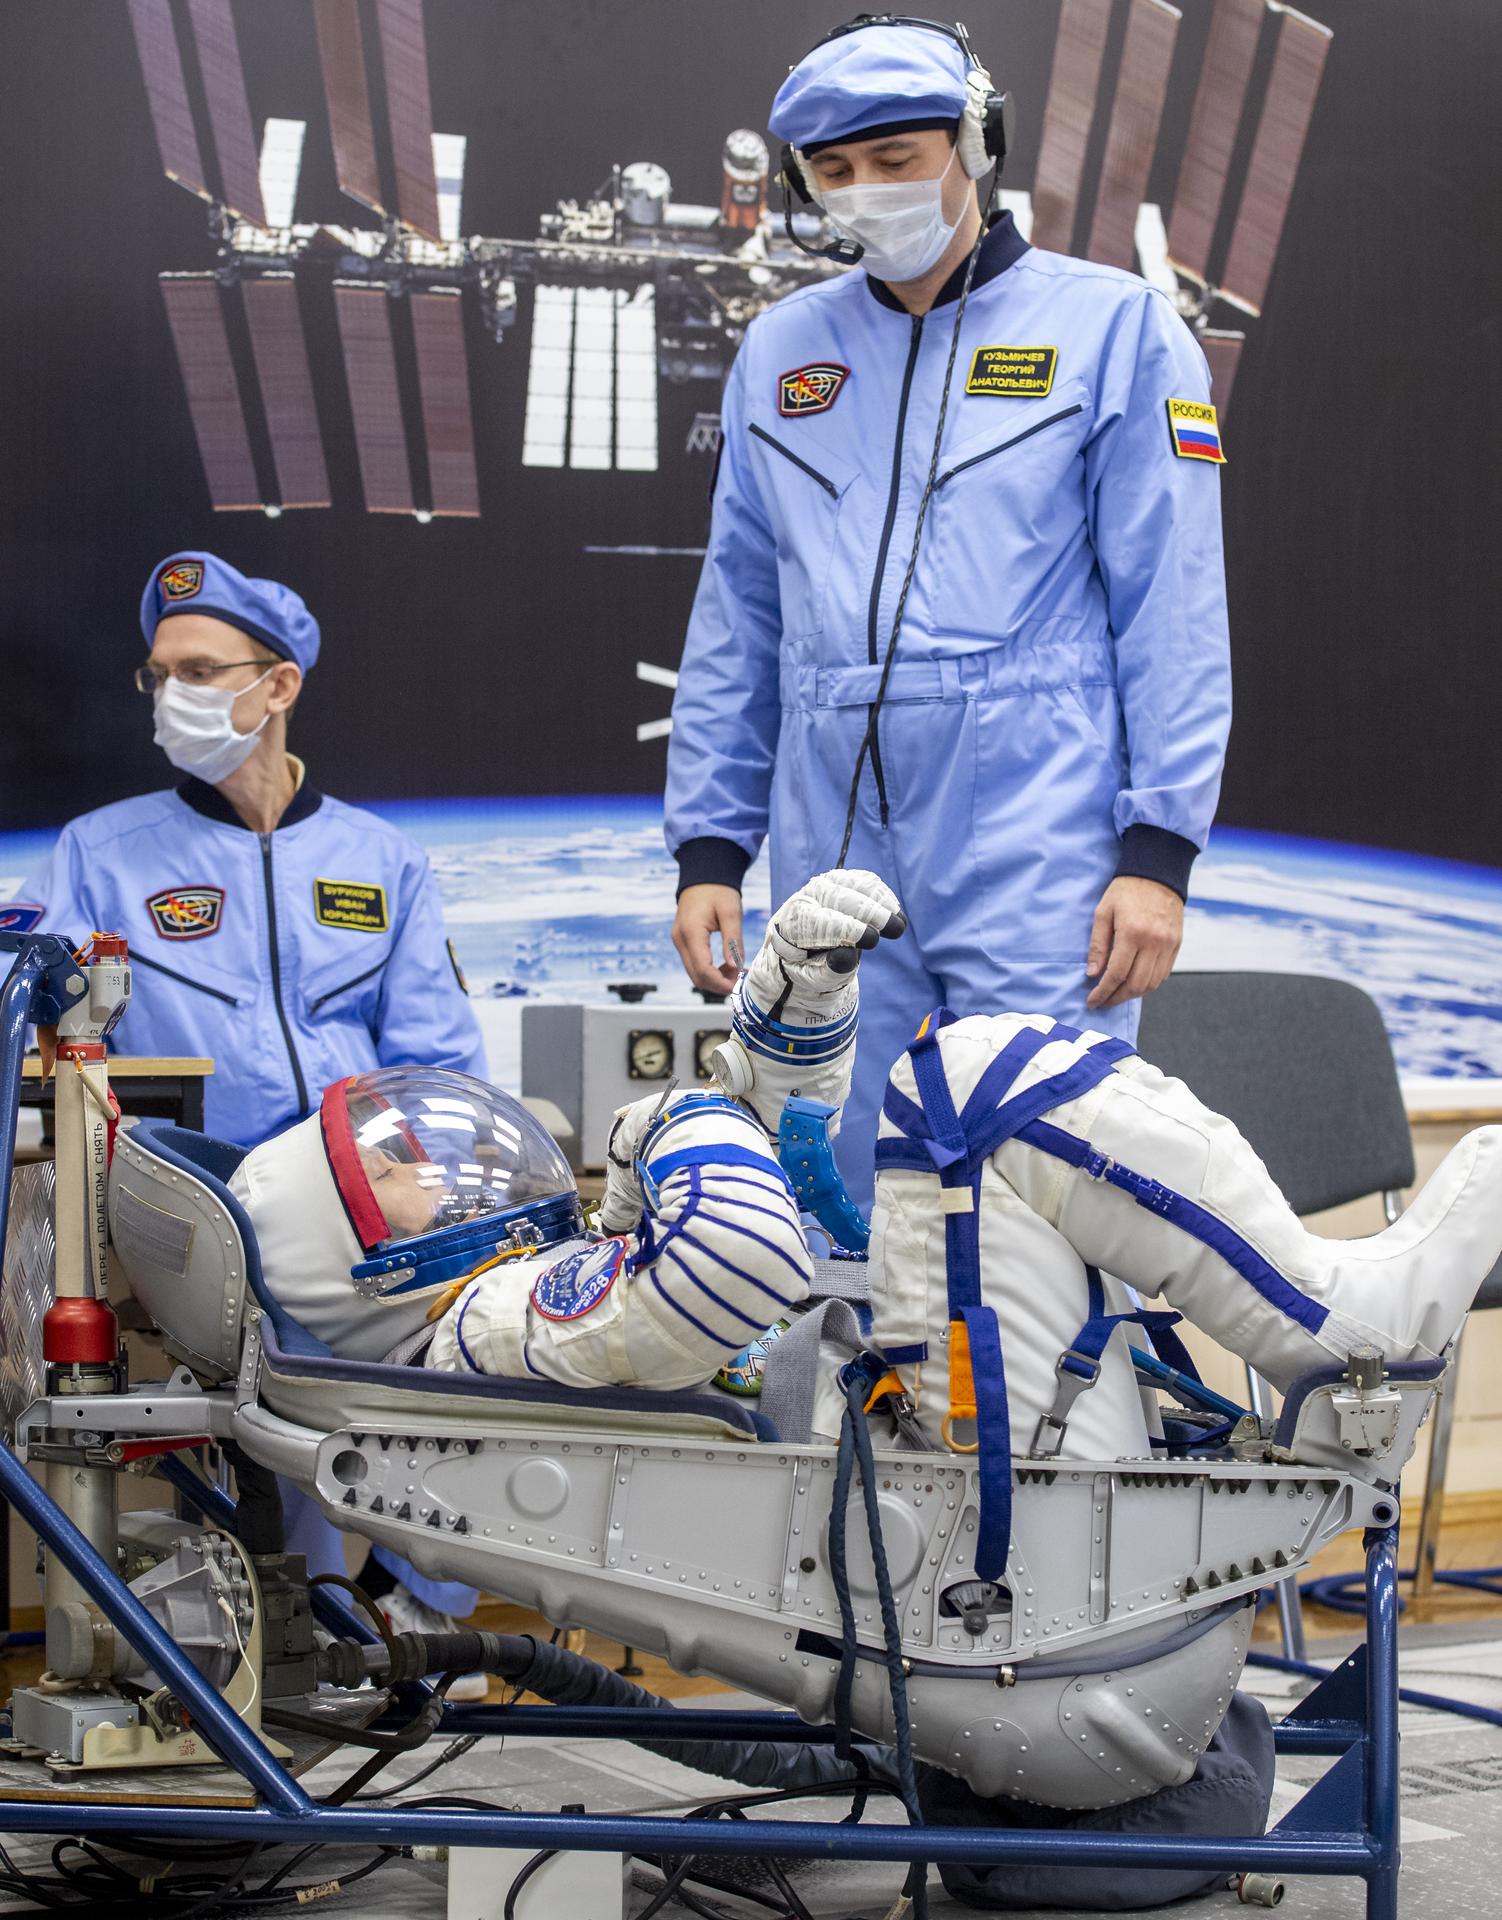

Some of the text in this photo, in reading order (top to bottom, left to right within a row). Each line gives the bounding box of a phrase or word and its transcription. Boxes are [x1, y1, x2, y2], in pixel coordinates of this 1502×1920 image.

[983, 351, 1046, 361] КУЗЬМИЧЕВ
[987, 364, 1036, 374] ГЕОРГИЙ
[971, 377, 1048, 389] АНАТОЛЬЕВИЧ
[1173, 402, 1213, 421] РОССИЯ
[94, 1122, 108, 1285] ПЕРЕД ПОЛЕТОМ СНЯТЬ
[570, 1290, 590, 1315] СОЮЗ
